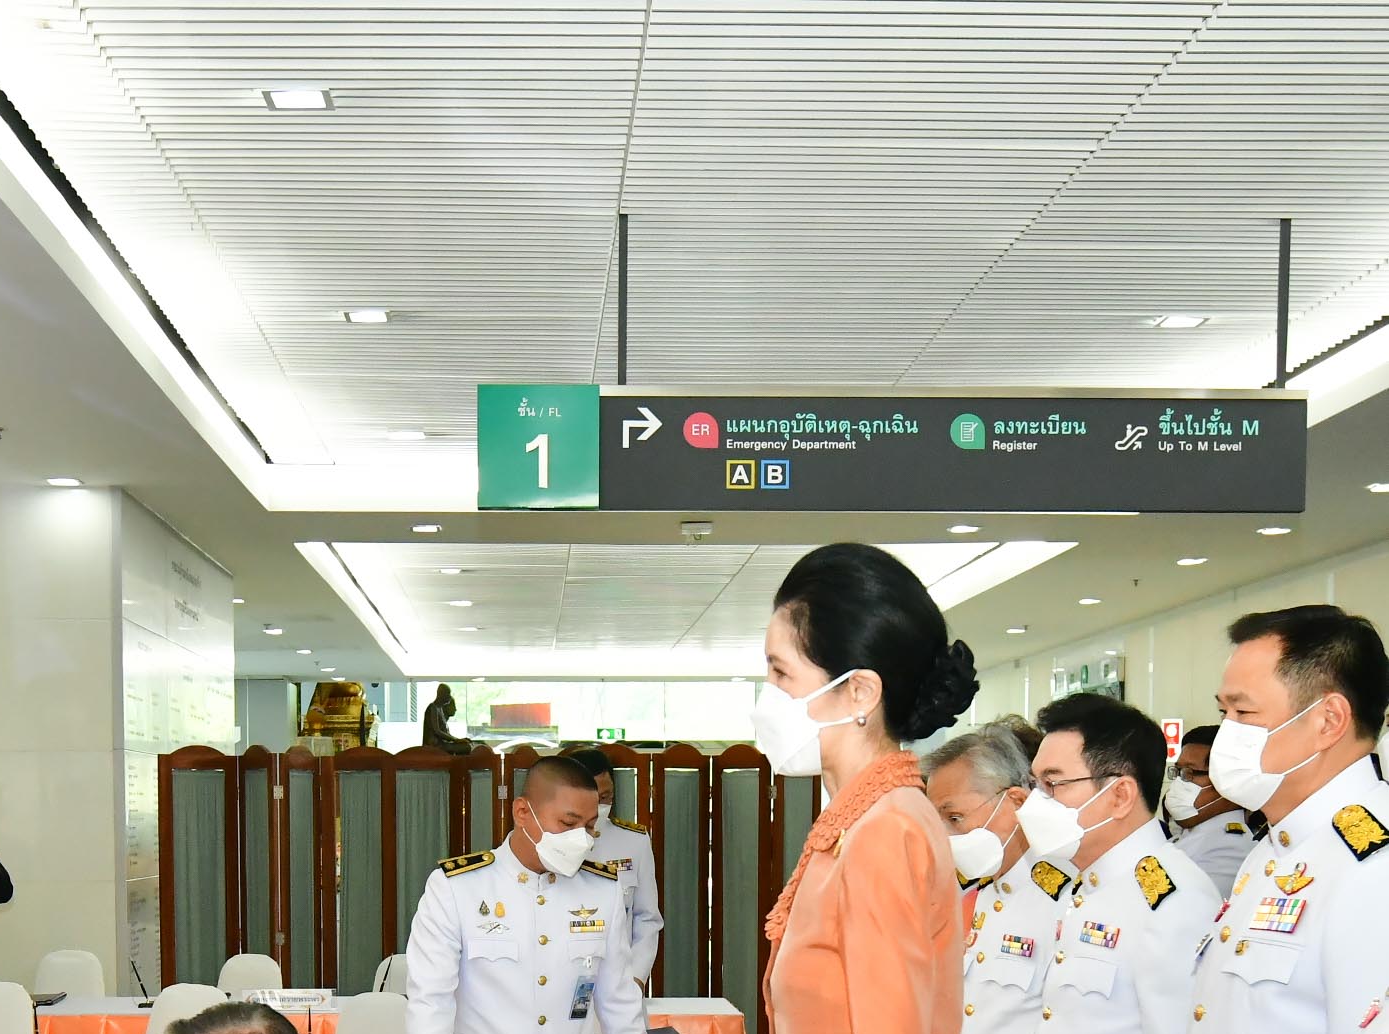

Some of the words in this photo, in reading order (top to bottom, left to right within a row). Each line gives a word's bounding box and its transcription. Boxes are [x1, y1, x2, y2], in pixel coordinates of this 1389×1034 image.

[517, 397, 536, 417] ชั้น
[548, 407, 562, 417] FL
[691, 424, 710, 436] ER
[726, 413, 919, 441] แผนกอุบัติเหตุ-ฉุกเฉิน
[993, 413, 1087, 435] ลงทะเบียน
[1158, 407, 1233, 436] ขึ้นไปชั้น
[1242, 419, 1259, 436] M
[726, 439, 787, 451] Emergency
[792, 439, 857, 451] Department
[992, 440, 1038, 453] Register
[1158, 441, 1174, 453] Up
[1178, 441, 1193, 451] To
[1197, 441, 1209, 451] M
[1213, 441, 1242, 451] Level
[525, 433, 549, 489] 1
[731, 465, 750, 484] A
[767, 465, 784, 484] B
